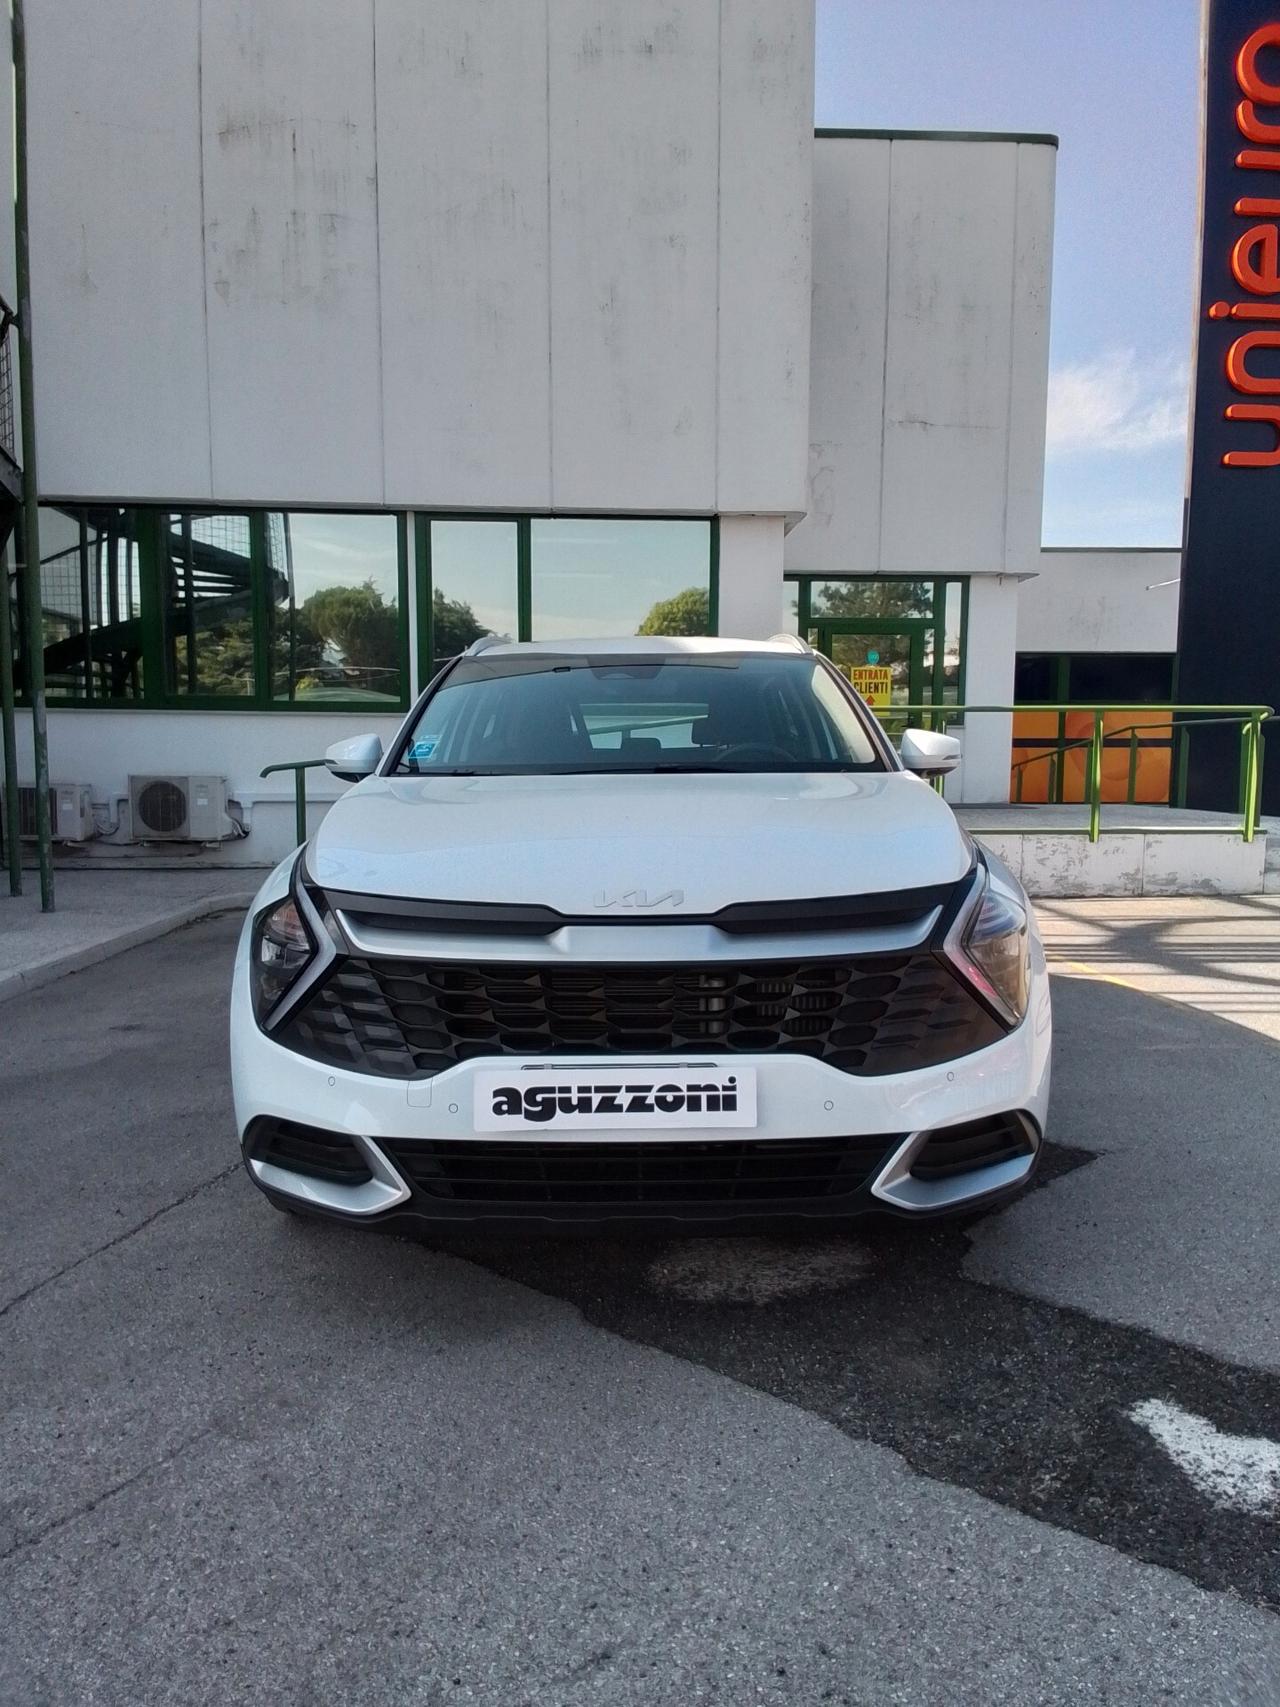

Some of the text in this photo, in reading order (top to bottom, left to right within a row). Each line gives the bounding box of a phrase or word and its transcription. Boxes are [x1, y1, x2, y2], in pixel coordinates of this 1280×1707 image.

[853, 669, 889, 680] ENTRATA
[854, 681, 889, 694] CLIENTI
[594, 888, 685, 908] KIA
[492, 1076, 737, 1122] aguzzoni
